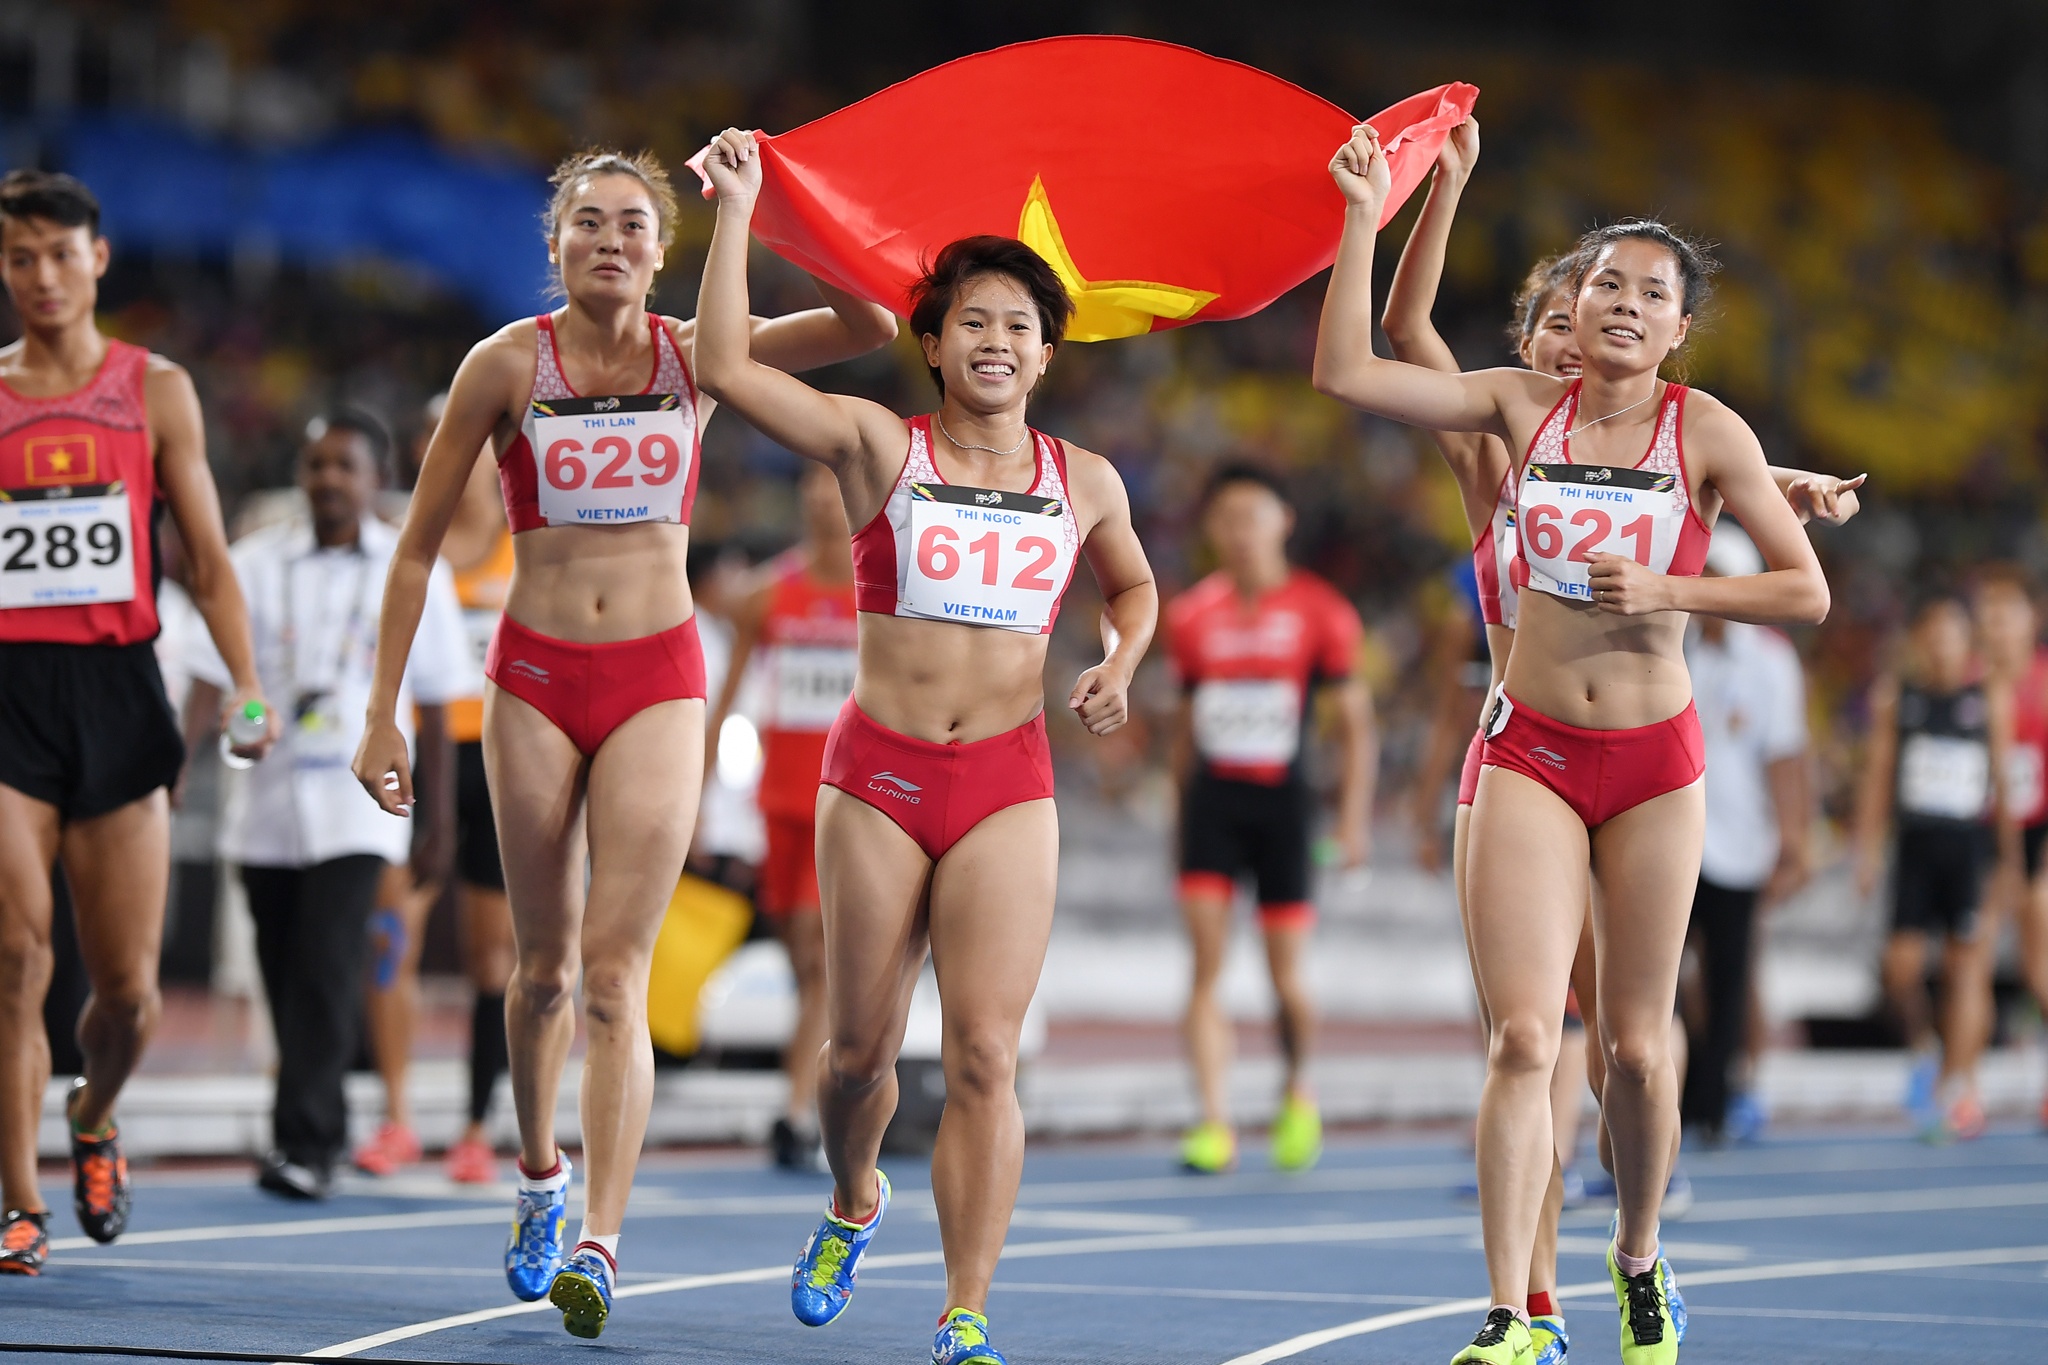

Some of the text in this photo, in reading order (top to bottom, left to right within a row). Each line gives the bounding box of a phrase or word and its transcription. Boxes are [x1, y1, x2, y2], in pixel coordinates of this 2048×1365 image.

[583, 417, 636, 428] THI LAN
[544, 433, 681, 491] 629
[1559, 487, 1633, 503] THI HUYEN
[576, 506, 649, 520] VIETNAM
[955, 509, 1022, 525] THI NGOC
[1525, 503, 1654, 567] 621
[3, 522, 123, 572] 289
[917, 525, 1057, 591] 612
[1555, 580, 1593, 597] VIET
[943, 602, 1018, 621] VIETNAM
[1526, 753, 1566, 771] LI-NING
[867, 781, 921, 804] LI-NING
